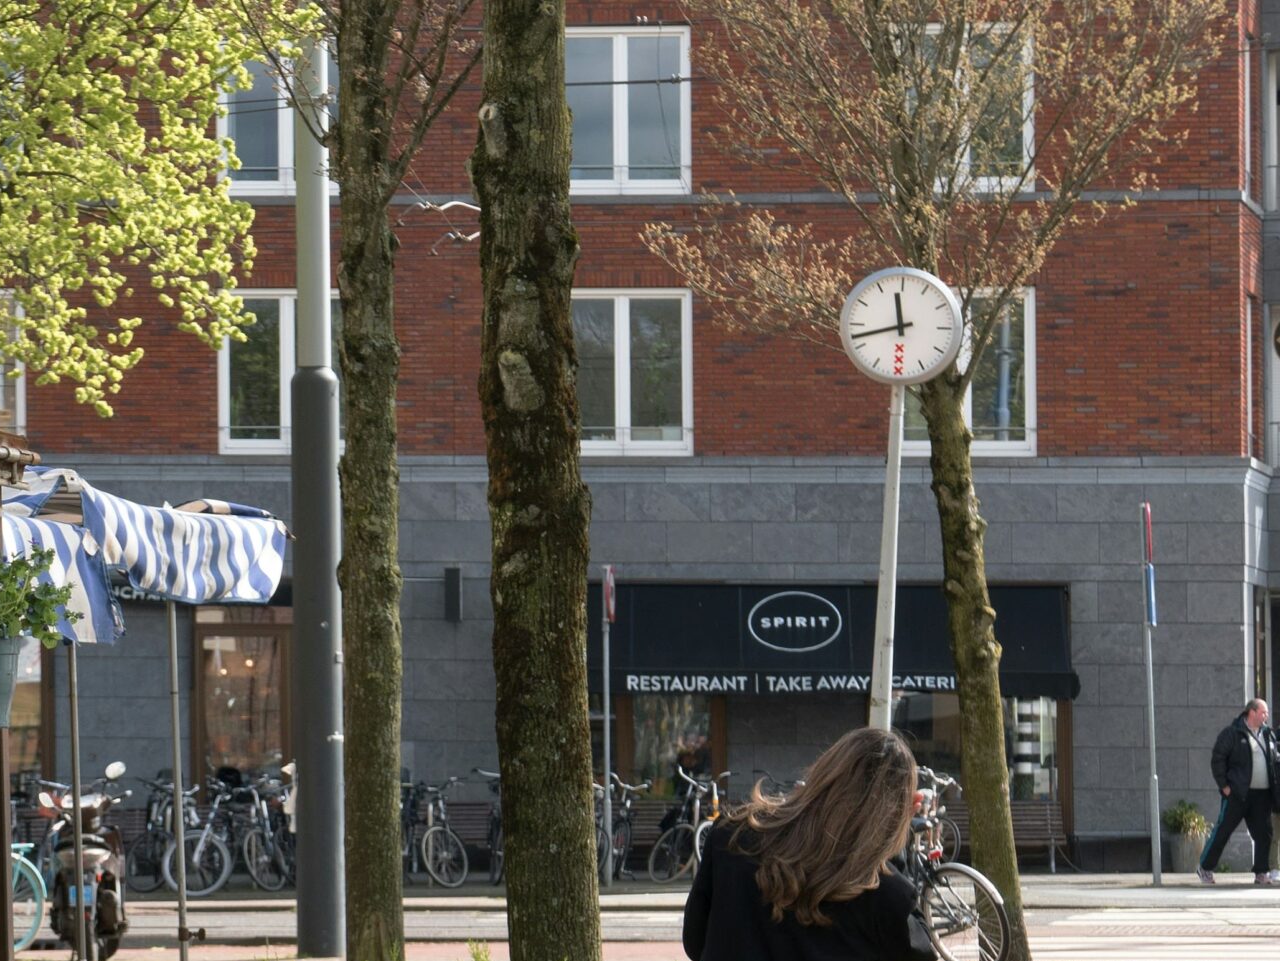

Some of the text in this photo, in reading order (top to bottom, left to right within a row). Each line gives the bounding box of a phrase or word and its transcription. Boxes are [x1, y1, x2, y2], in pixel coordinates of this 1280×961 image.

[760, 616, 830, 629] SPIRIT
[626, 674, 956, 692] RESTAURANT TAKE AWAY CATERI
